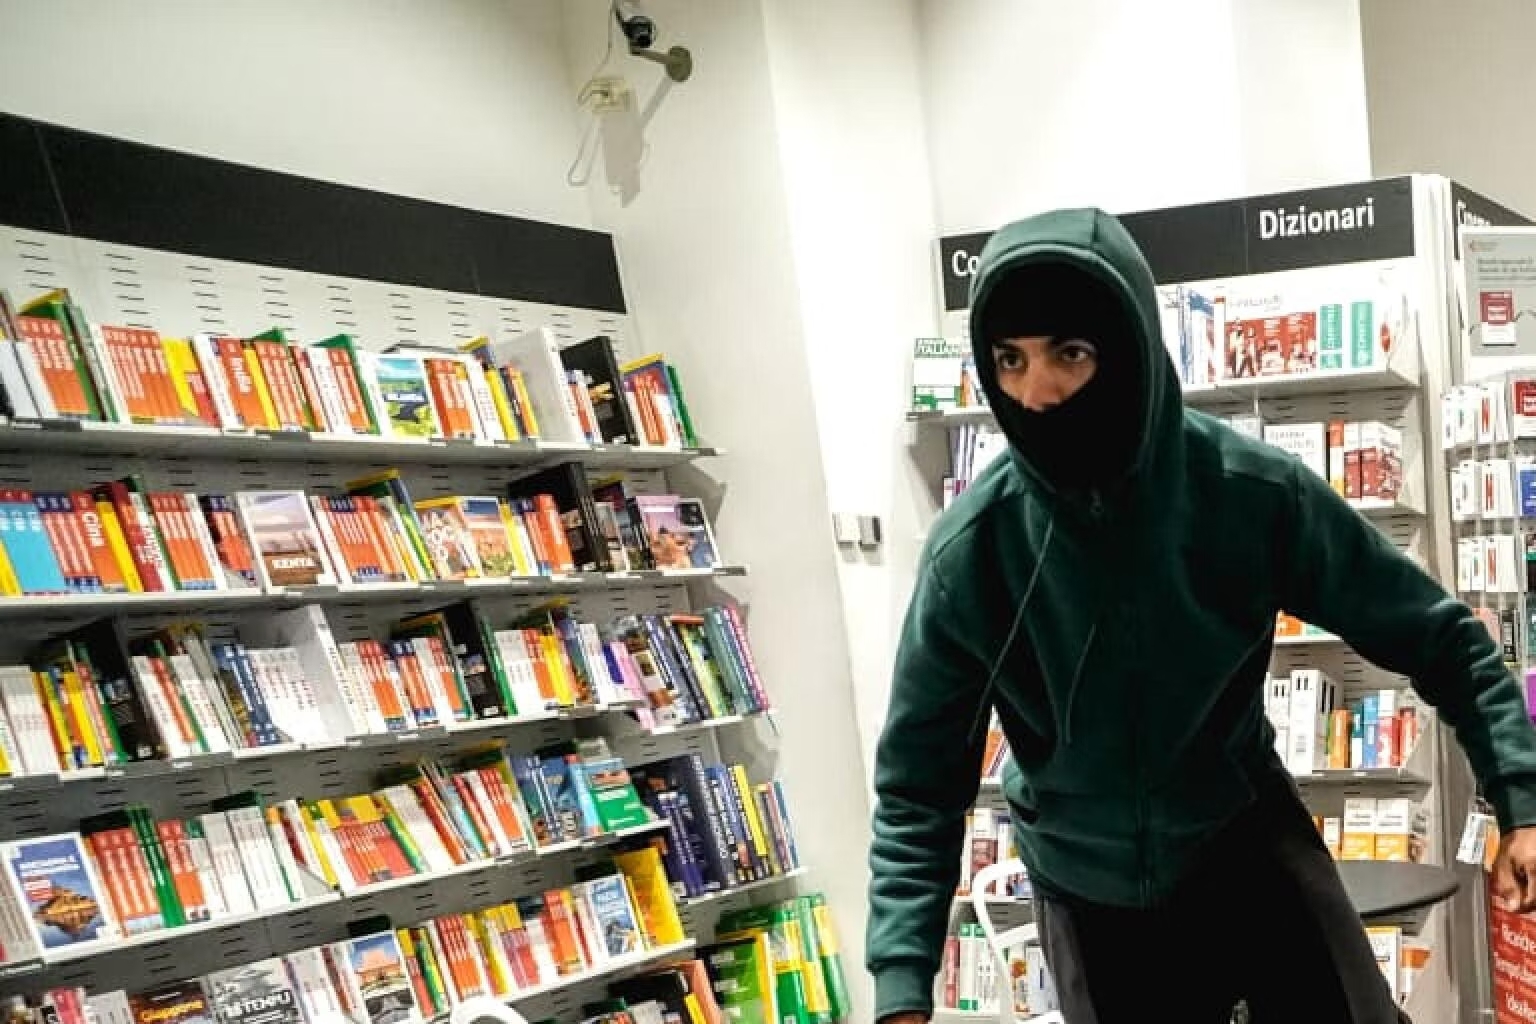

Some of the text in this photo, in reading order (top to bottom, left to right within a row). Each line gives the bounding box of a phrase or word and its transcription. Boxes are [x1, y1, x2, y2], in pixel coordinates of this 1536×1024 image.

[1258, 197, 1376, 241] Dizionari
[952, 249, 978, 277] Co
[81, 511, 105, 548] Cina
